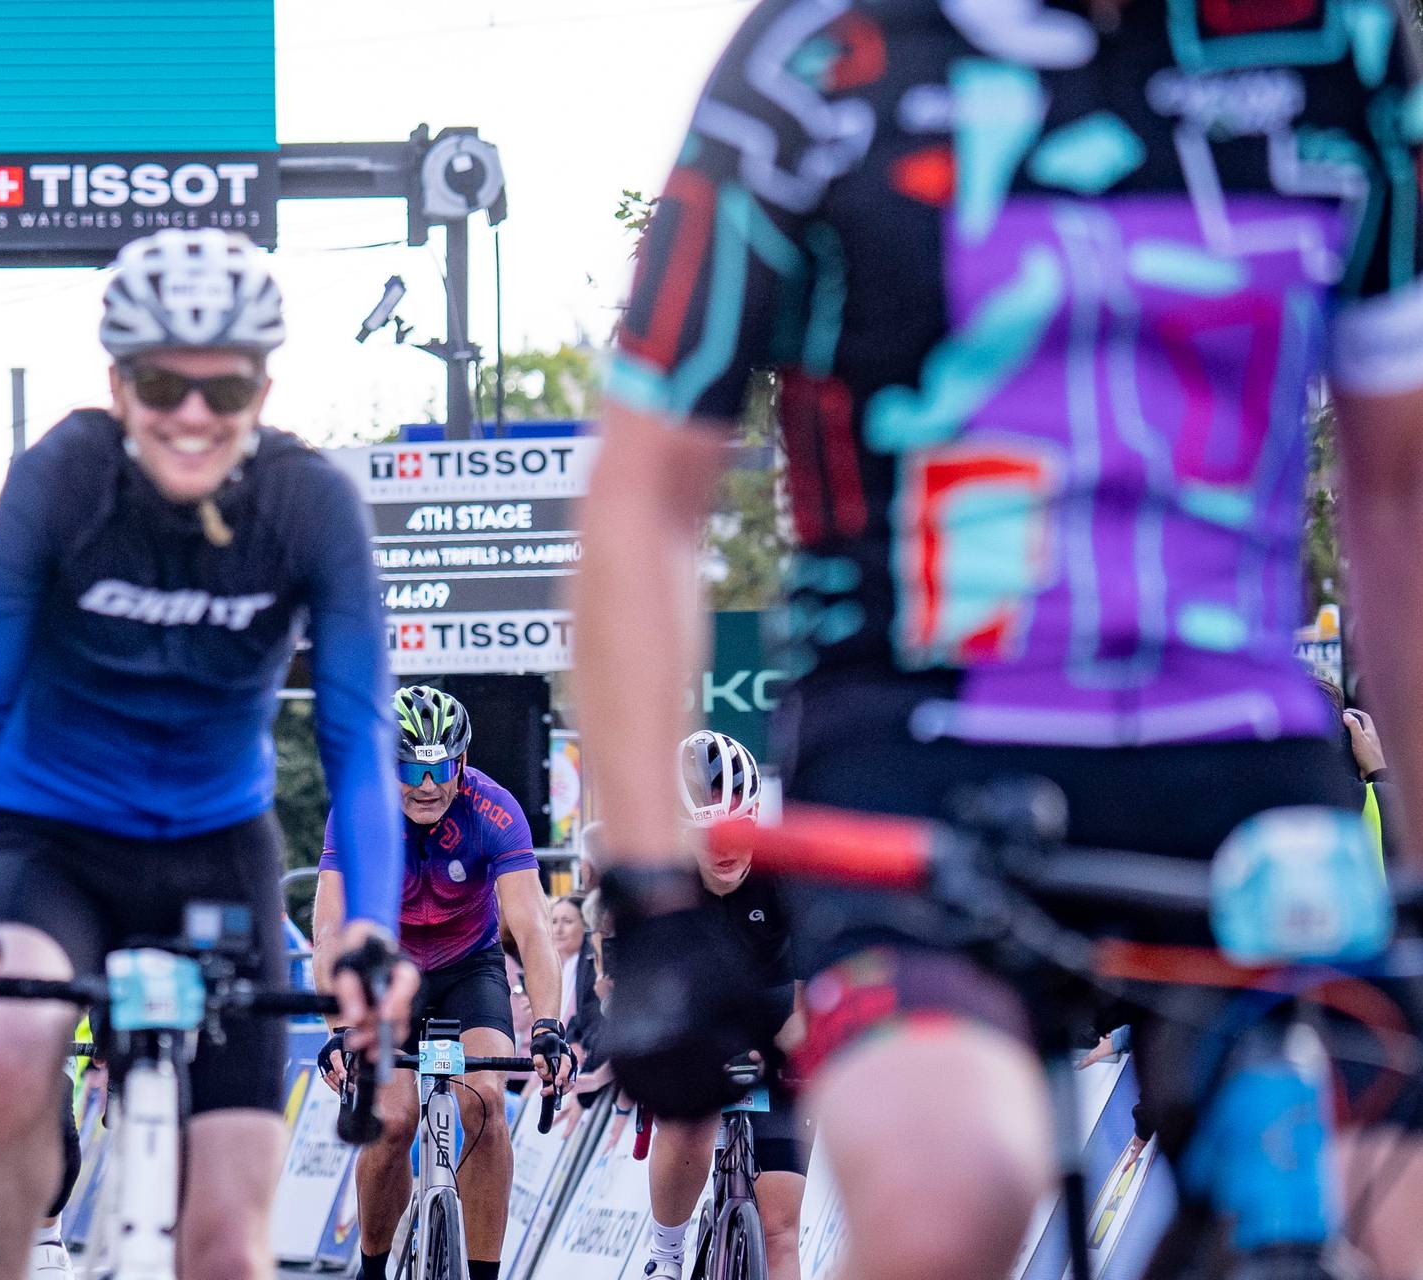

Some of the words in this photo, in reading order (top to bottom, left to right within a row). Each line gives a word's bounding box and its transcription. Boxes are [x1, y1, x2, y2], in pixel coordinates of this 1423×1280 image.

[29, 163, 259, 207] TISSOT
[18, 211, 122, 228] WATCHES
[131, 211, 199, 228] SINCE
[430, 449, 574, 477] TISSOT
[406, 505, 453, 532] 4TH
[455, 503, 533, 531] STAGE
[441, 546, 500, 566] TRIFELS
[431, 620, 573, 650] TISSOT
